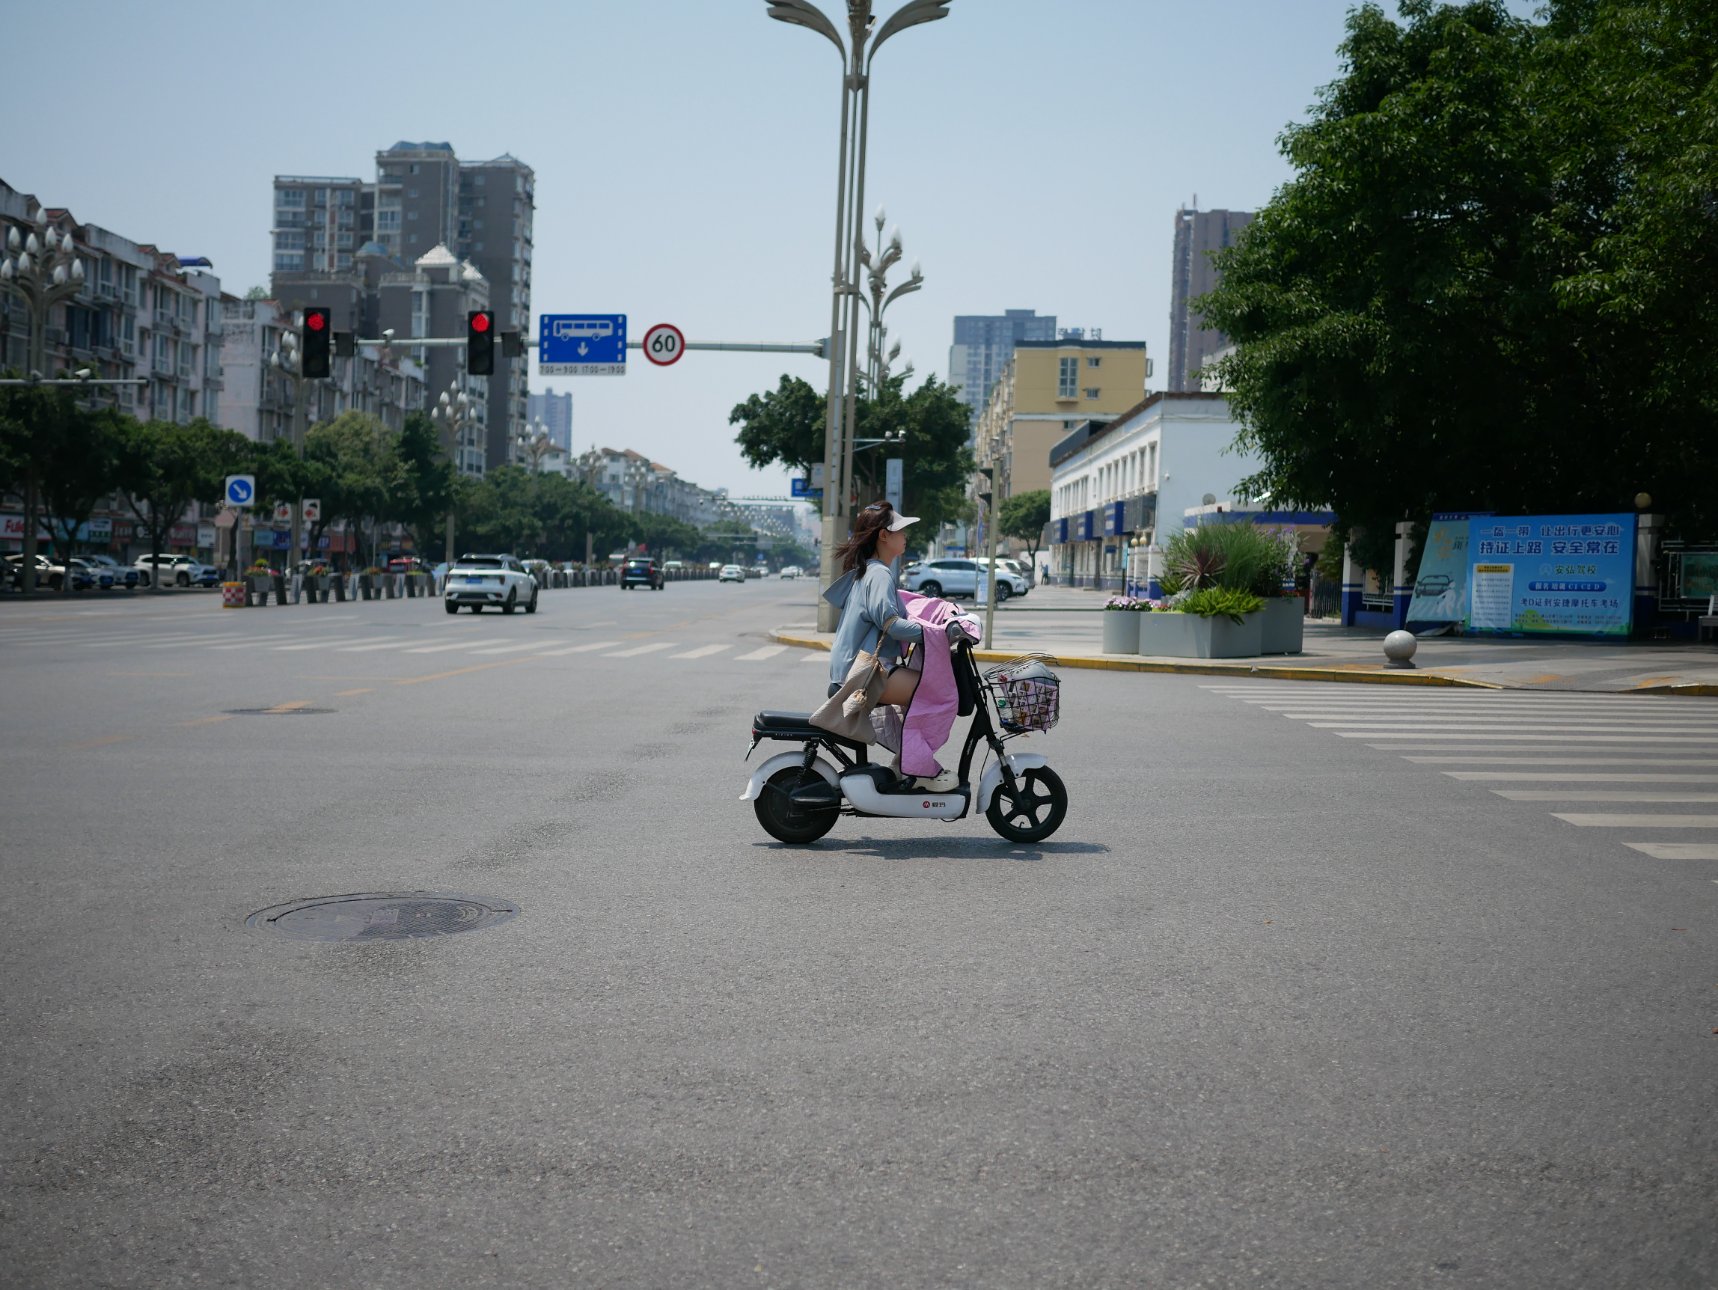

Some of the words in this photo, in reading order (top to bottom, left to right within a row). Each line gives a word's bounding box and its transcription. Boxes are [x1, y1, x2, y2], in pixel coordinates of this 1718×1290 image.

[652, 334, 675, 353] 60
[1541, 525, 1621, 537] 让出行更安心
[1480, 541, 1543, 554] 持证上路
[1552, 541, 1620, 554] 安全常在
